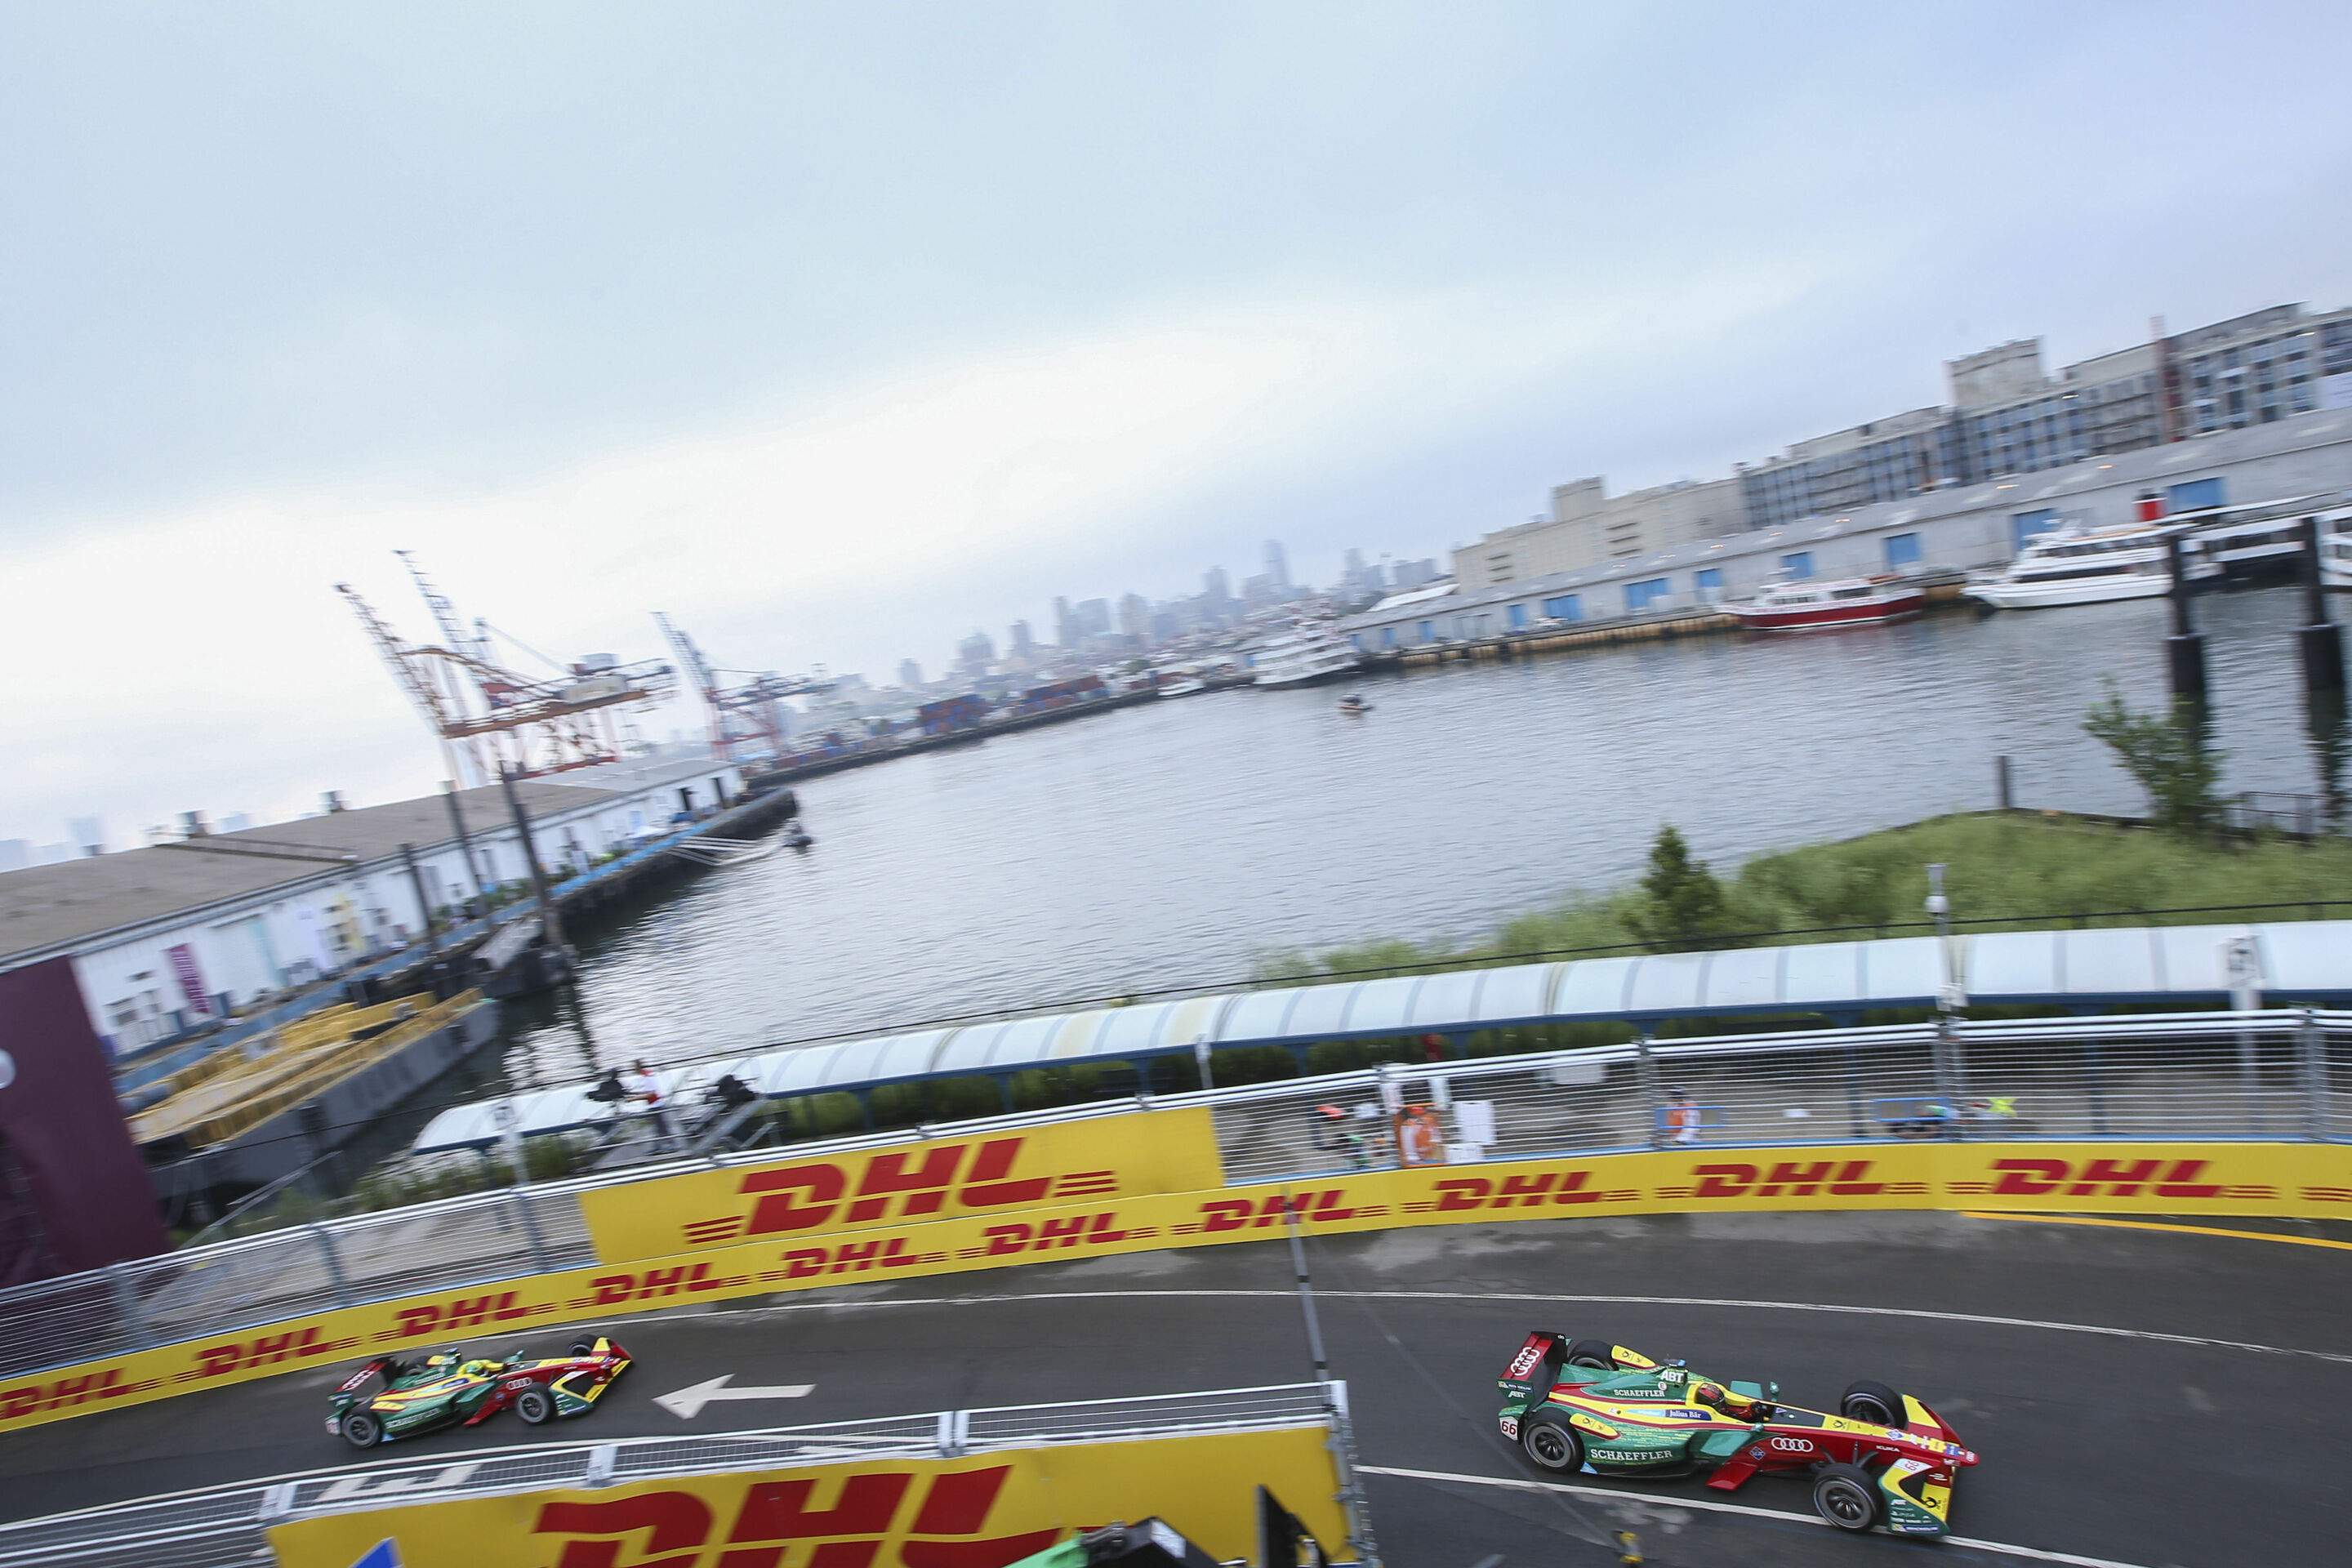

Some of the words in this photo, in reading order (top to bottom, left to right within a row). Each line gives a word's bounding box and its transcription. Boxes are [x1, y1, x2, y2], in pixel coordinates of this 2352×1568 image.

[737, 1137, 1054, 1235] DHL
[1433, 1171, 1601, 1211] DHL
[1690, 1160, 1883, 1197] DHL
[1990, 1158, 2223, 1198] DHL
[1200, 1189, 1355, 1232] DHL
[982, 1213, 1128, 1256] DHL
[782, 1237, 920, 1278] DHL
[590, 1263, 723, 1305] DHL
[395, 1291, 527, 1339] DHL
[193, 1326, 329, 1378] DHL
[0, 1367, 131, 1419] DHL
[1614, 1389, 1666, 1397] SCHAEFFLER
[1660, 1371, 1684, 1383] ABT
[1501, 1421, 1517, 1435] 66
[1669, 1410, 1688, 1418] Julius
[1590, 1449, 1673, 1461] SCHAEFFLER
[533, 1465, 1063, 1568] DHL
